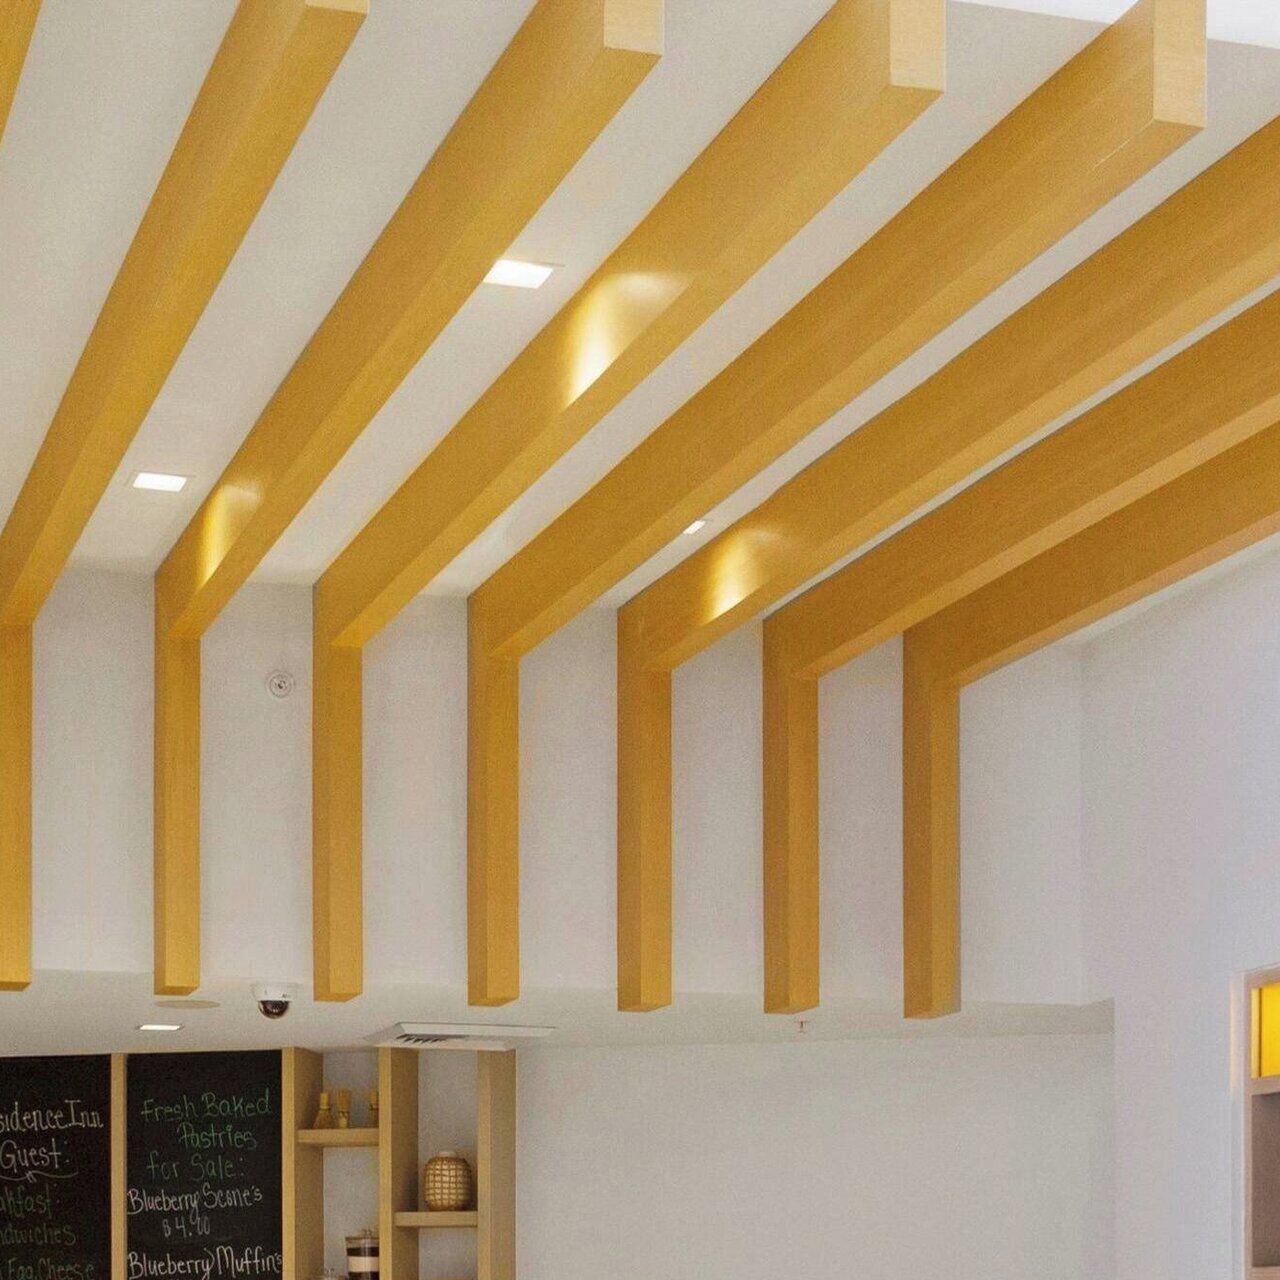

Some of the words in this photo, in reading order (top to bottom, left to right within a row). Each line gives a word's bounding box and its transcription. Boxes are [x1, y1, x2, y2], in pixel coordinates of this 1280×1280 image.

[64, 1099, 105, 1130] Inn
[141, 1094, 202, 1122] Fresh
[202, 1087, 272, 1119] Baked
[177, 1121, 258, 1151] Pastries
[146, 1150, 181, 1181] for
[191, 1153, 246, 1182] Sale:
[127, 1187, 201, 1226] Blueberry
[202, 1181, 263, 1210] Scone's
[216, 1245, 281, 1280] Muffin's
